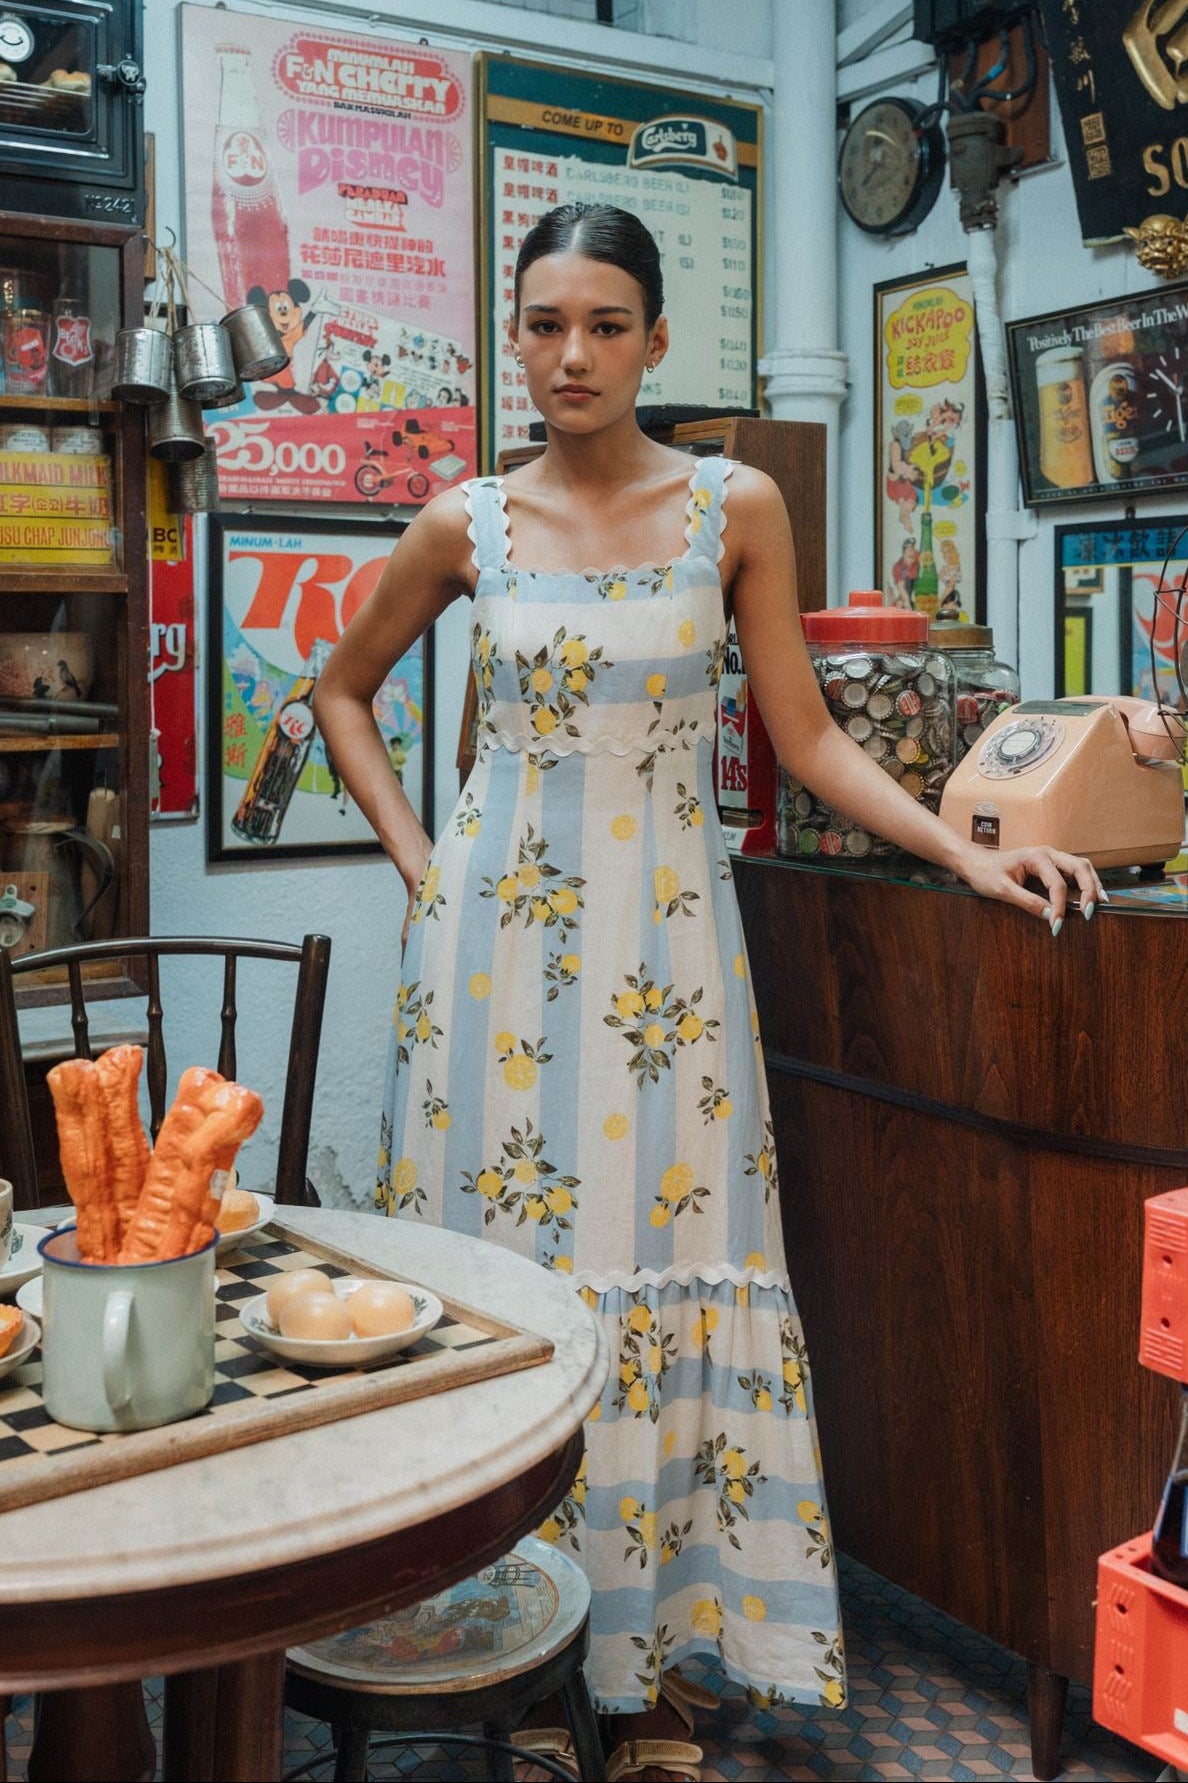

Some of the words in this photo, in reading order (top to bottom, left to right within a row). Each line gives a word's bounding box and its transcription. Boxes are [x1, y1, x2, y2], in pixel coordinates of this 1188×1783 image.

[541, 110, 580, 126] COME
[584, 119, 603, 132] UP
[607, 123, 624, 136] TO
[641, 127, 698, 152] Carlsberg
[890, 307, 965, 340] KICKAPOO
[1072, 327, 1094, 342] The
[1153, 307, 1177, 325] The
[204, 421, 346, 476] 25,000
[24, 526, 55, 546] CHAP
